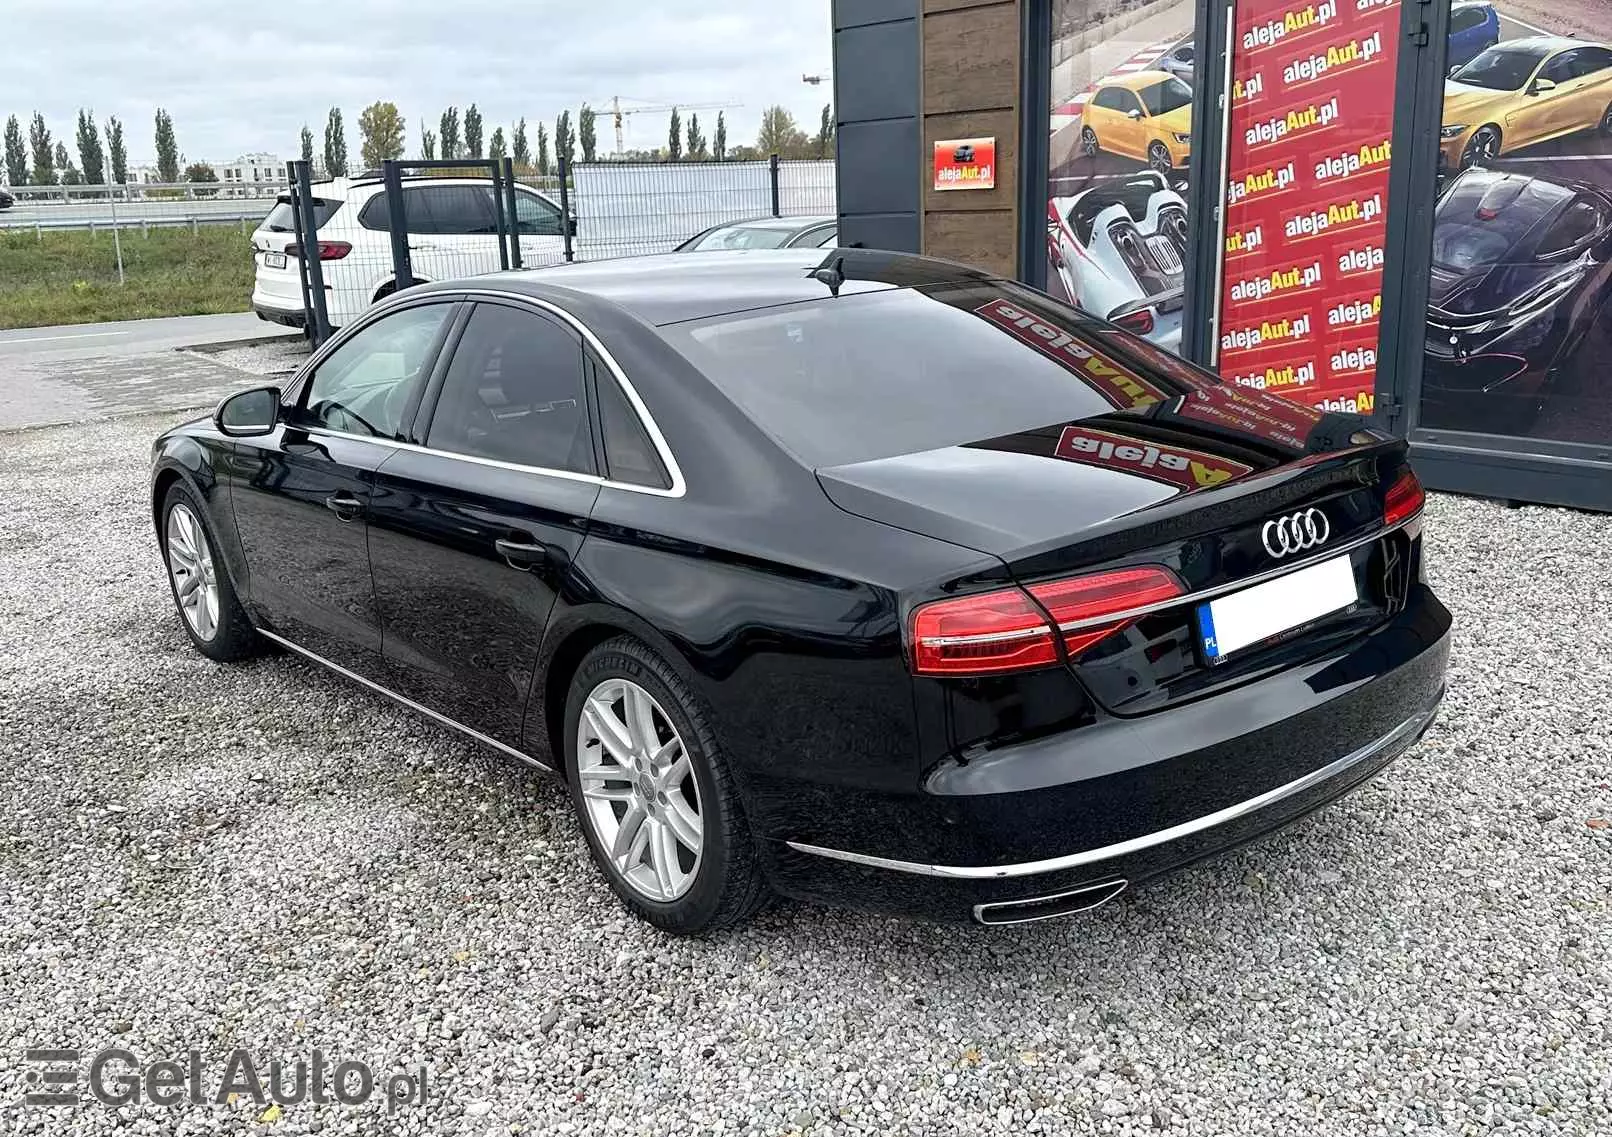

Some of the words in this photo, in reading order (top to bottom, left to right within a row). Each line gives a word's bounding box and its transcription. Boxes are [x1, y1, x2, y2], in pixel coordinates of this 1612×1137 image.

[1243, 0, 1337, 49] alejaAut.pl
[1283, 32, 1381, 83] alejaAut.pl
[1246, 97, 1339, 145] alejaAut.pl
[938, 165, 991, 182] alejaAut.pl
[1315, 140, 1391, 179] alejaAut
[1285, 194, 1381, 236] alejaAut.pl
[1339, 246, 1384, 272] aleja
[1231, 262, 1321, 300] alejaAut.pl
[1222, 314, 1310, 349] alejaAut.pl
[1331, 347, 1376, 371] aleja
[1205, 638, 1217, 648] PL
